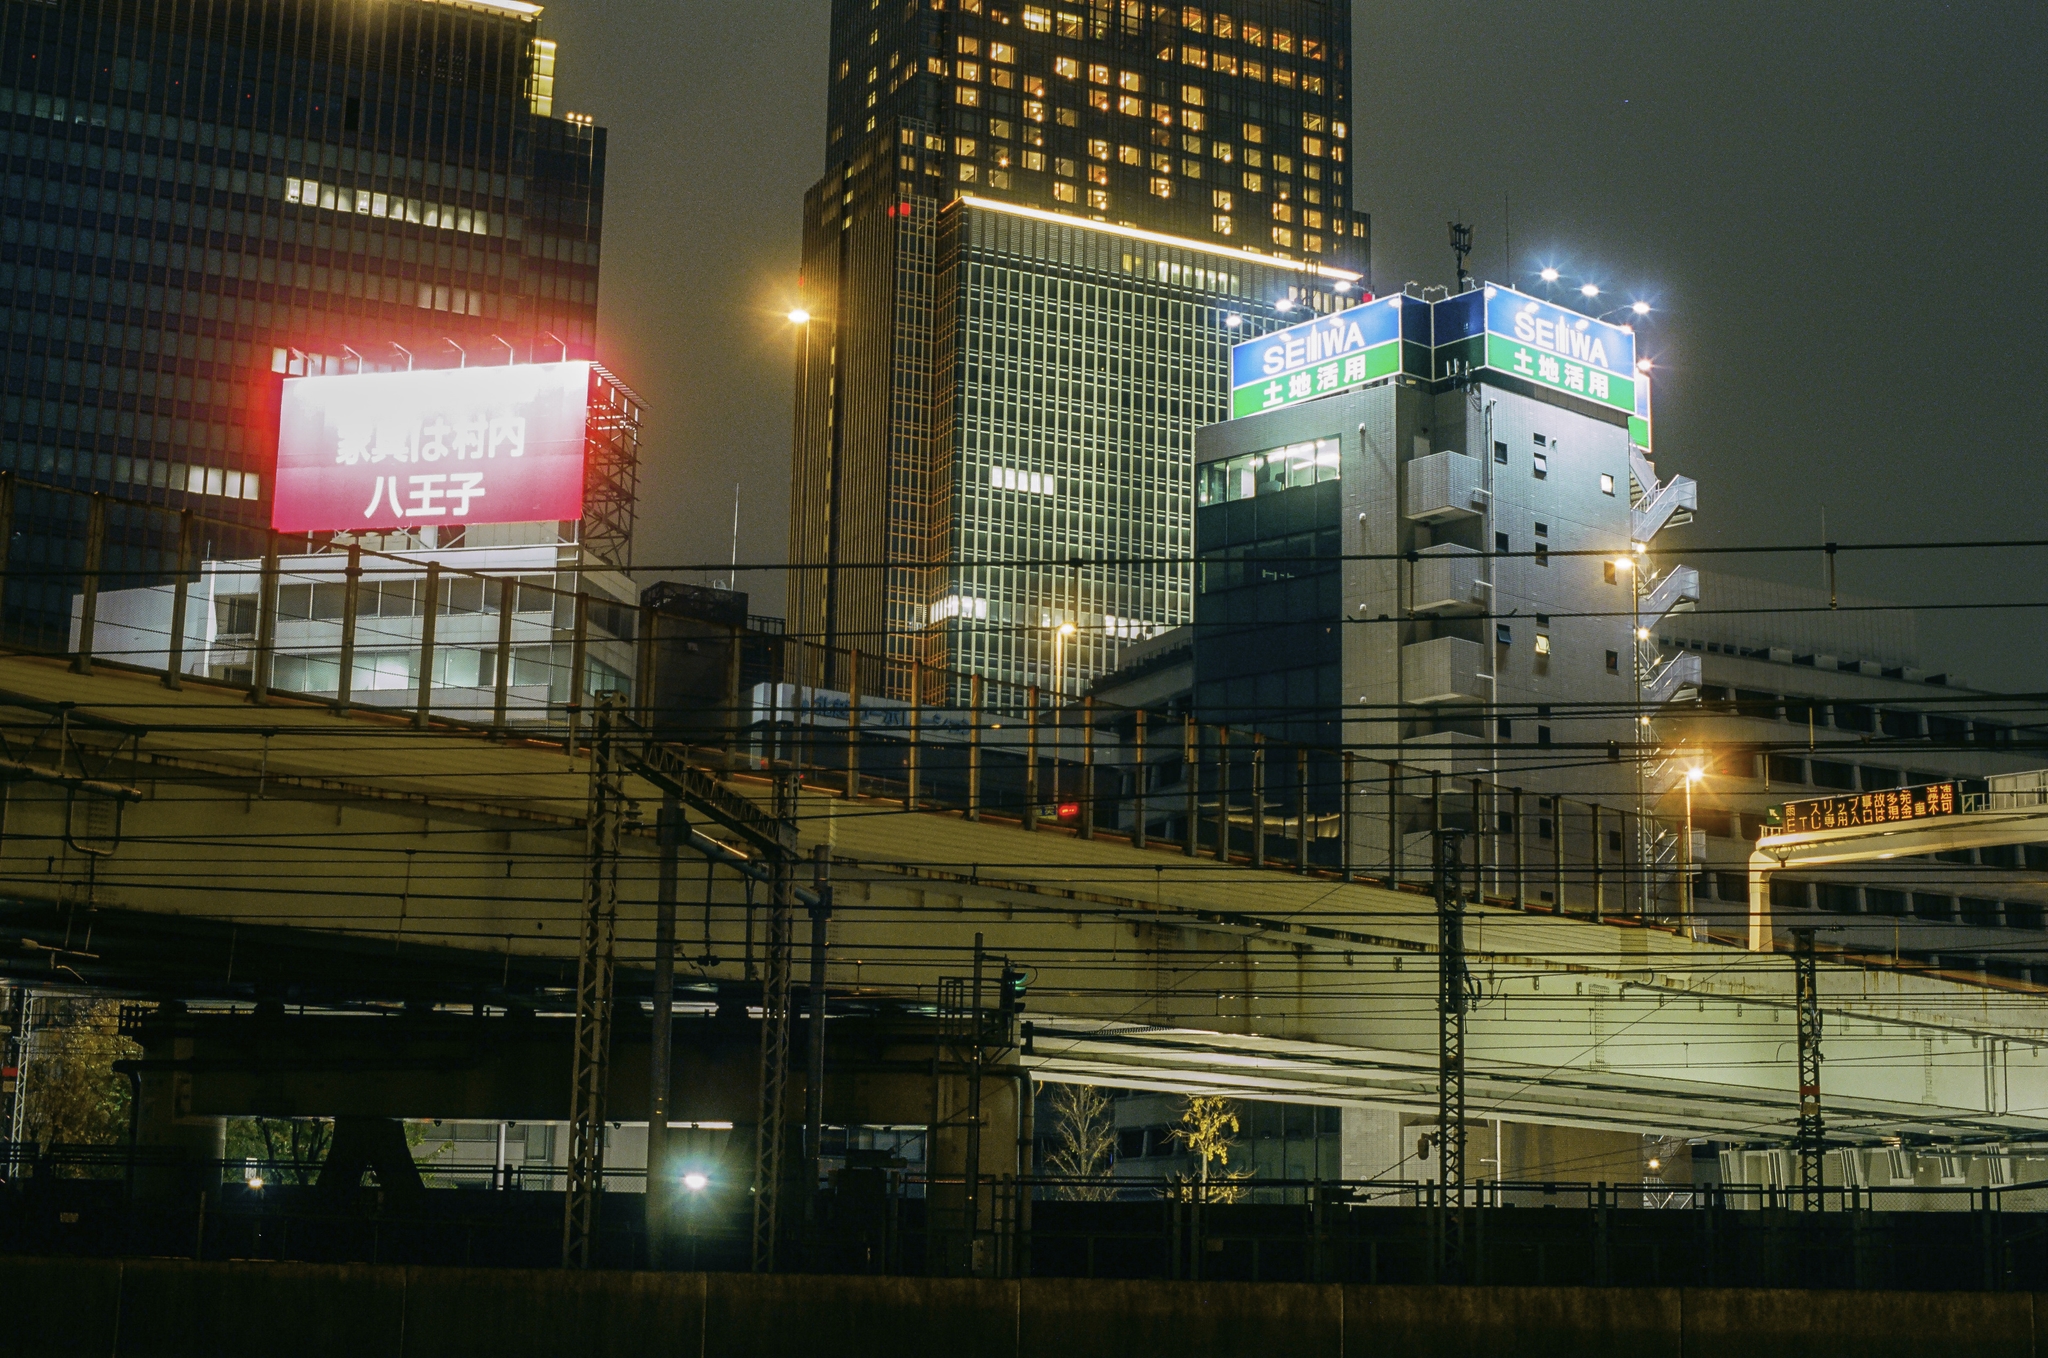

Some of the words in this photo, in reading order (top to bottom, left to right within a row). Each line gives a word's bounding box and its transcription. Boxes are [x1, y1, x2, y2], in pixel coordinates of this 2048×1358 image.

[1263, 320, 1365, 376] SEIWA
[1514, 311, 1608, 368] SEIWA
[1263, 354, 1366, 408] 土地活用
[1514, 348, 1609, 400] 土地活用
[335, 413, 525, 466] 家具は村内
[363, 471, 486, 519] 八王子
[1785, 804, 1796, 816] 雨
[1810, 789, 1912, 816] スリップ事故多発
[1785, 799, 1953, 833] ETC専用入口は現金車不可
